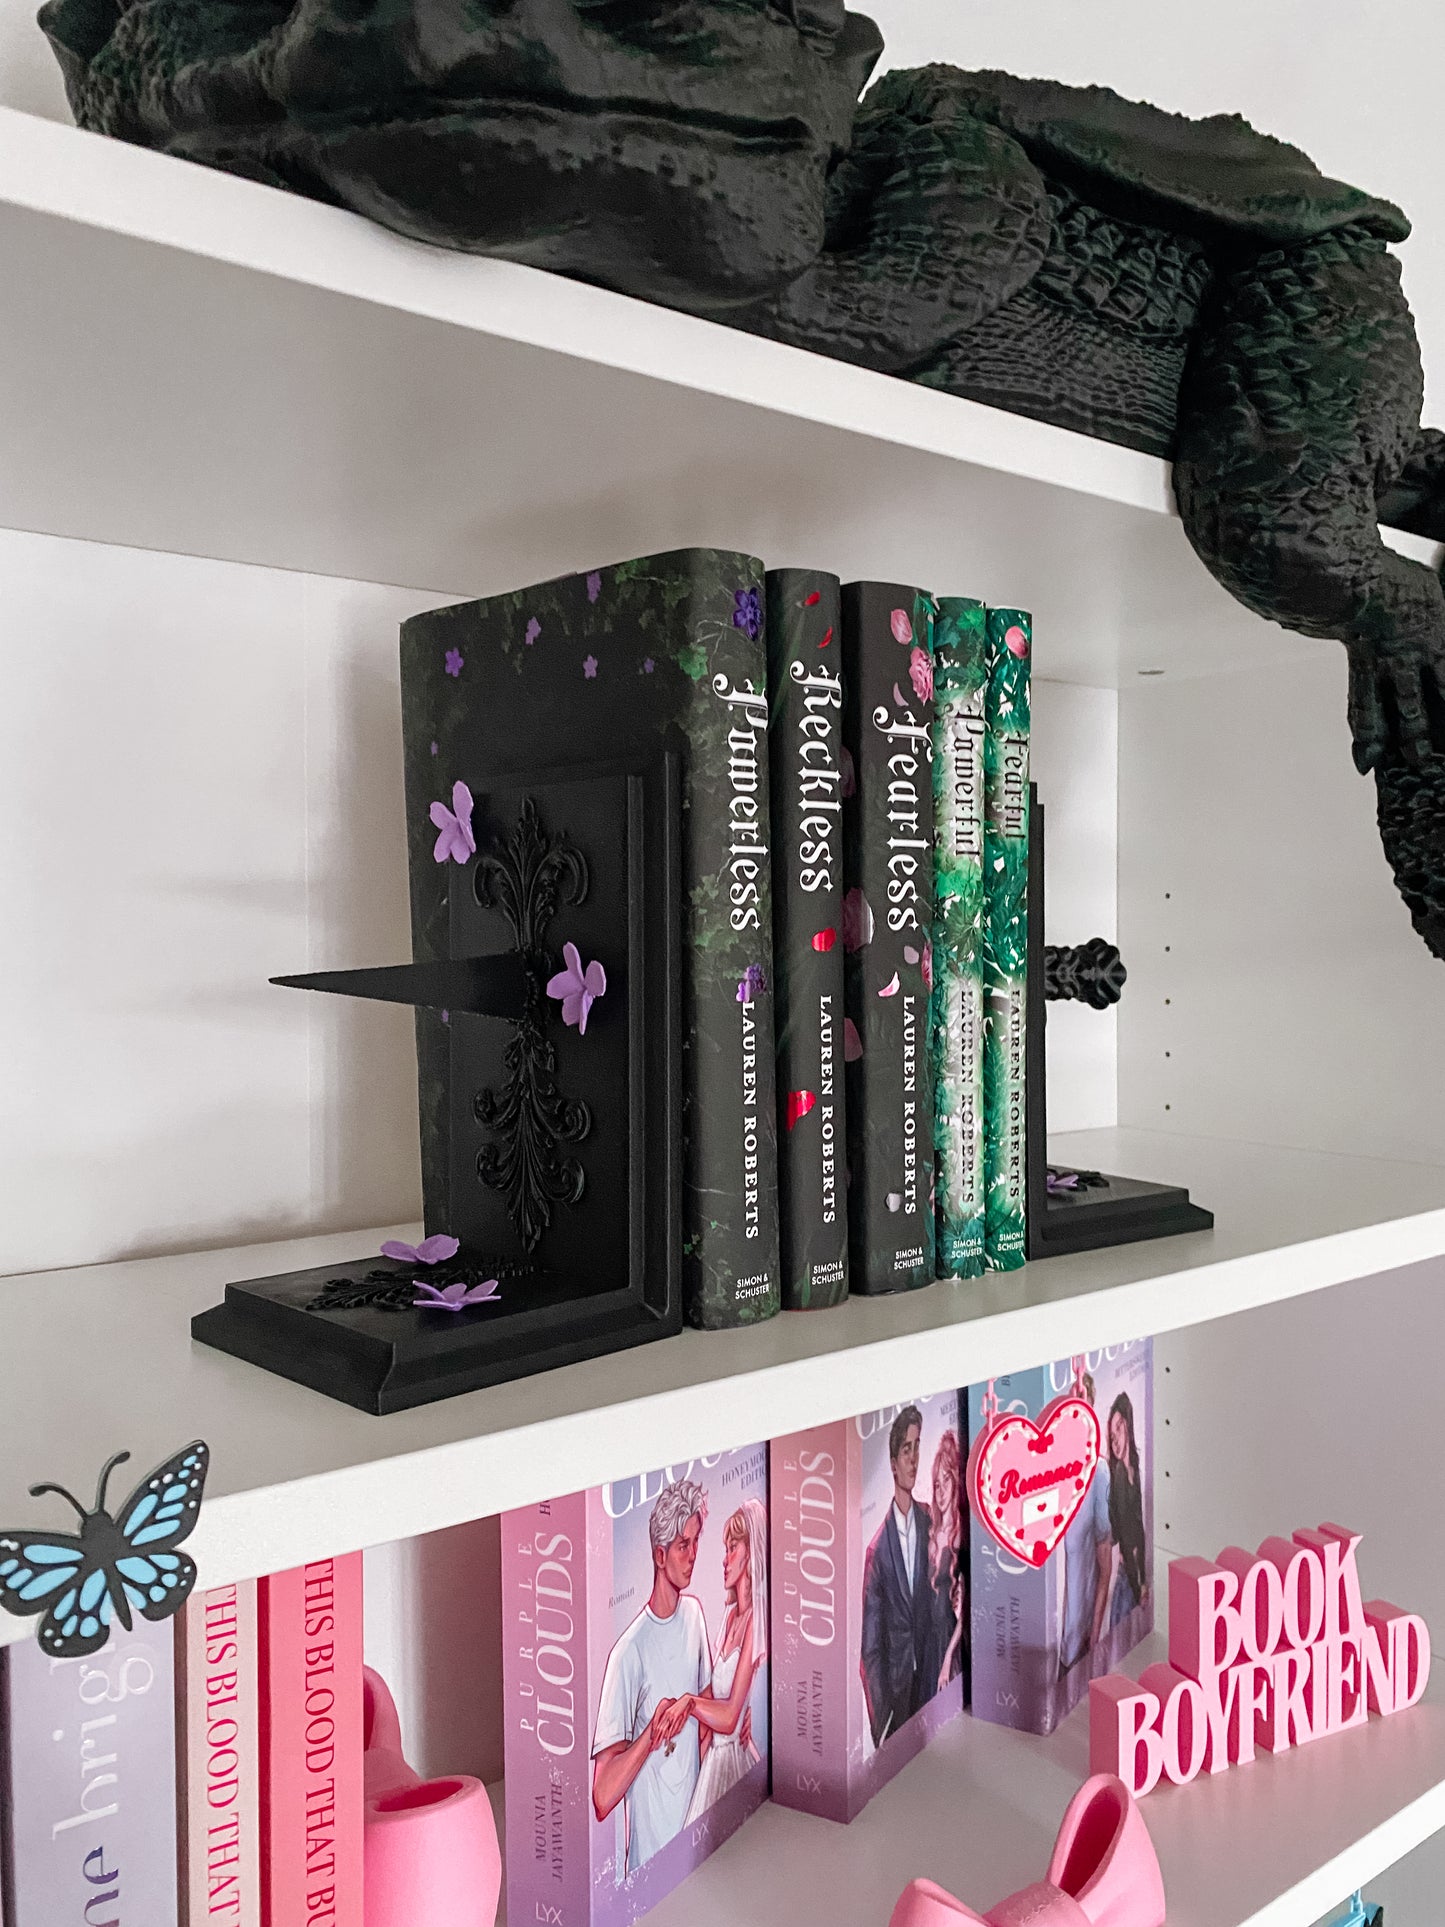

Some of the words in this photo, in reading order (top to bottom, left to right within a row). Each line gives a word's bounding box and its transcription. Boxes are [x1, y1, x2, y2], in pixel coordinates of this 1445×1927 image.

[712, 672, 770, 932] Powerless
[789, 659, 843, 893] Reckless
[872, 705, 934, 932] Fearless
[944, 701, 990, 858] Powerful
[994, 729, 1029, 840] Fearful
[742, 1001, 758, 1106] LAUREN
[819, 994, 835, 1096] LAUREN
[903, 994, 917, 1092] LAUREN
[959, 989, 975, 1084] LAUREN
[1009, 988, 1022, 1081] LAUREN
[743, 1115, 759, 1239] ROBERTS
[821, 1105, 836, 1224] ROBERTS
[904, 1101, 917, 1215] ROBERTS
[960, 1094, 975, 1205] ROBERTS
[1009, 1090, 1021, 1199] ROBERTS
[736, 1274, 762, 1289] SIMON
[763, 1272, 769, 1282] &
[811, 1271, 845, 1286] SCHUSTER
[813, 1263, 838, 1275] SIMON
[838, 1260, 844, 1270] &
[894, 1256, 924, 1270] SCHUSTER
[895, 1249, 917, 1260] SIMON
[917, 1246, 923, 1256] &
[951, 1246, 983, 1259] SCHUSTER
[953, 1238, 976, 1249] SIMON
[976, 1237, 982, 1247] &
[997, 1239, 1025, 1252] SCHUSTER
[999, 1232, 1019, 1242] SIMON
[1019, 1230, 1024, 1239] &
[735, 1283, 770, 1300] SCHUSTER
[998, 1459, 1084, 1504] Romance
[783, 1459, 798, 1626] PURPLE
[799, 1450, 836, 1648] CLOUDS
[304, 1557, 335, 1639] THIS
[517, 1542, 535, 1732] PURPLE
[534, 1531, 576, 1757] CLOUDS
[1197, 1534, 1365, 1677] BOOK
[205, 1668, 240, 1809] BLOOD
[304, 1640, 336, 1774] BLOOD
[796, 1679, 809, 1739] MOUNIA
[812, 1669, 824, 1757] JAYAWANTH
[995, 1690, 1020, 1710] LYX
[1116, 1614, 1431, 1800] BOYFRIEND
[306, 1777, 336, 1879] THAT
[534, 1794, 548, 1862] MOUNIA
[551, 1783, 564, 1884] JAYAWANTH
[691, 1816, 710, 1848] LYX
[796, 1772, 822, 1796] LYX
[207, 1811, 241, 1918] THAT
[535, 1901, 564, 1927] LYX
